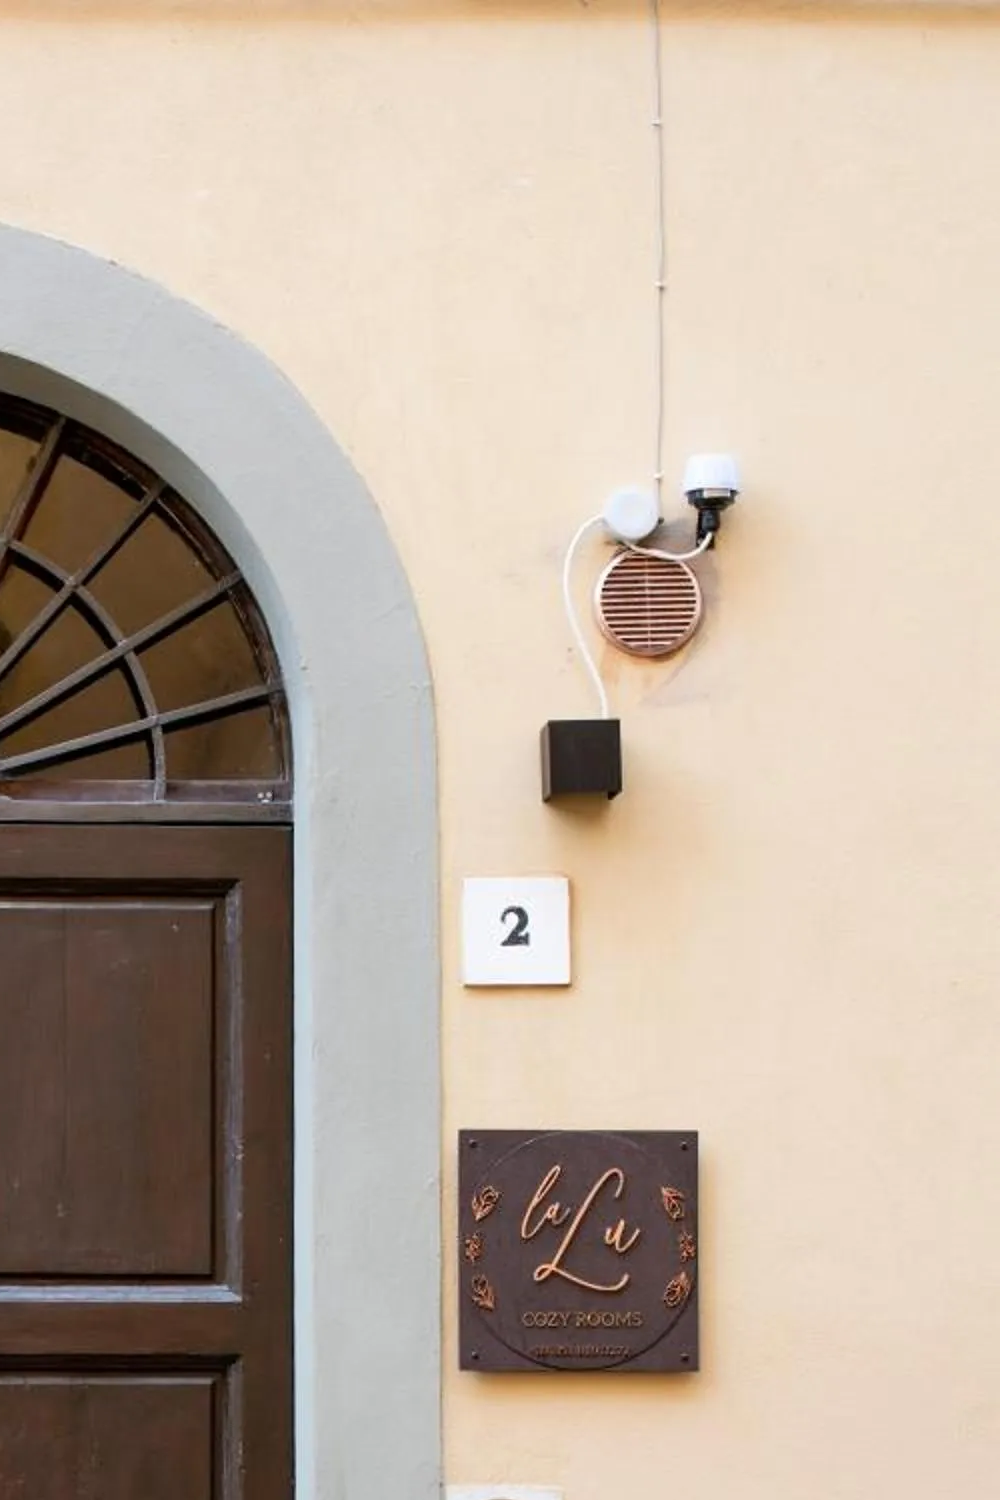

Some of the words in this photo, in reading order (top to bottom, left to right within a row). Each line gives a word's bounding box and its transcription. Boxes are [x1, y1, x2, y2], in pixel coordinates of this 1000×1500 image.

[500, 905, 530, 947] 2
[521, 1311, 571, 1328] COZY
[575, 1311, 643, 1328] ROOMS
